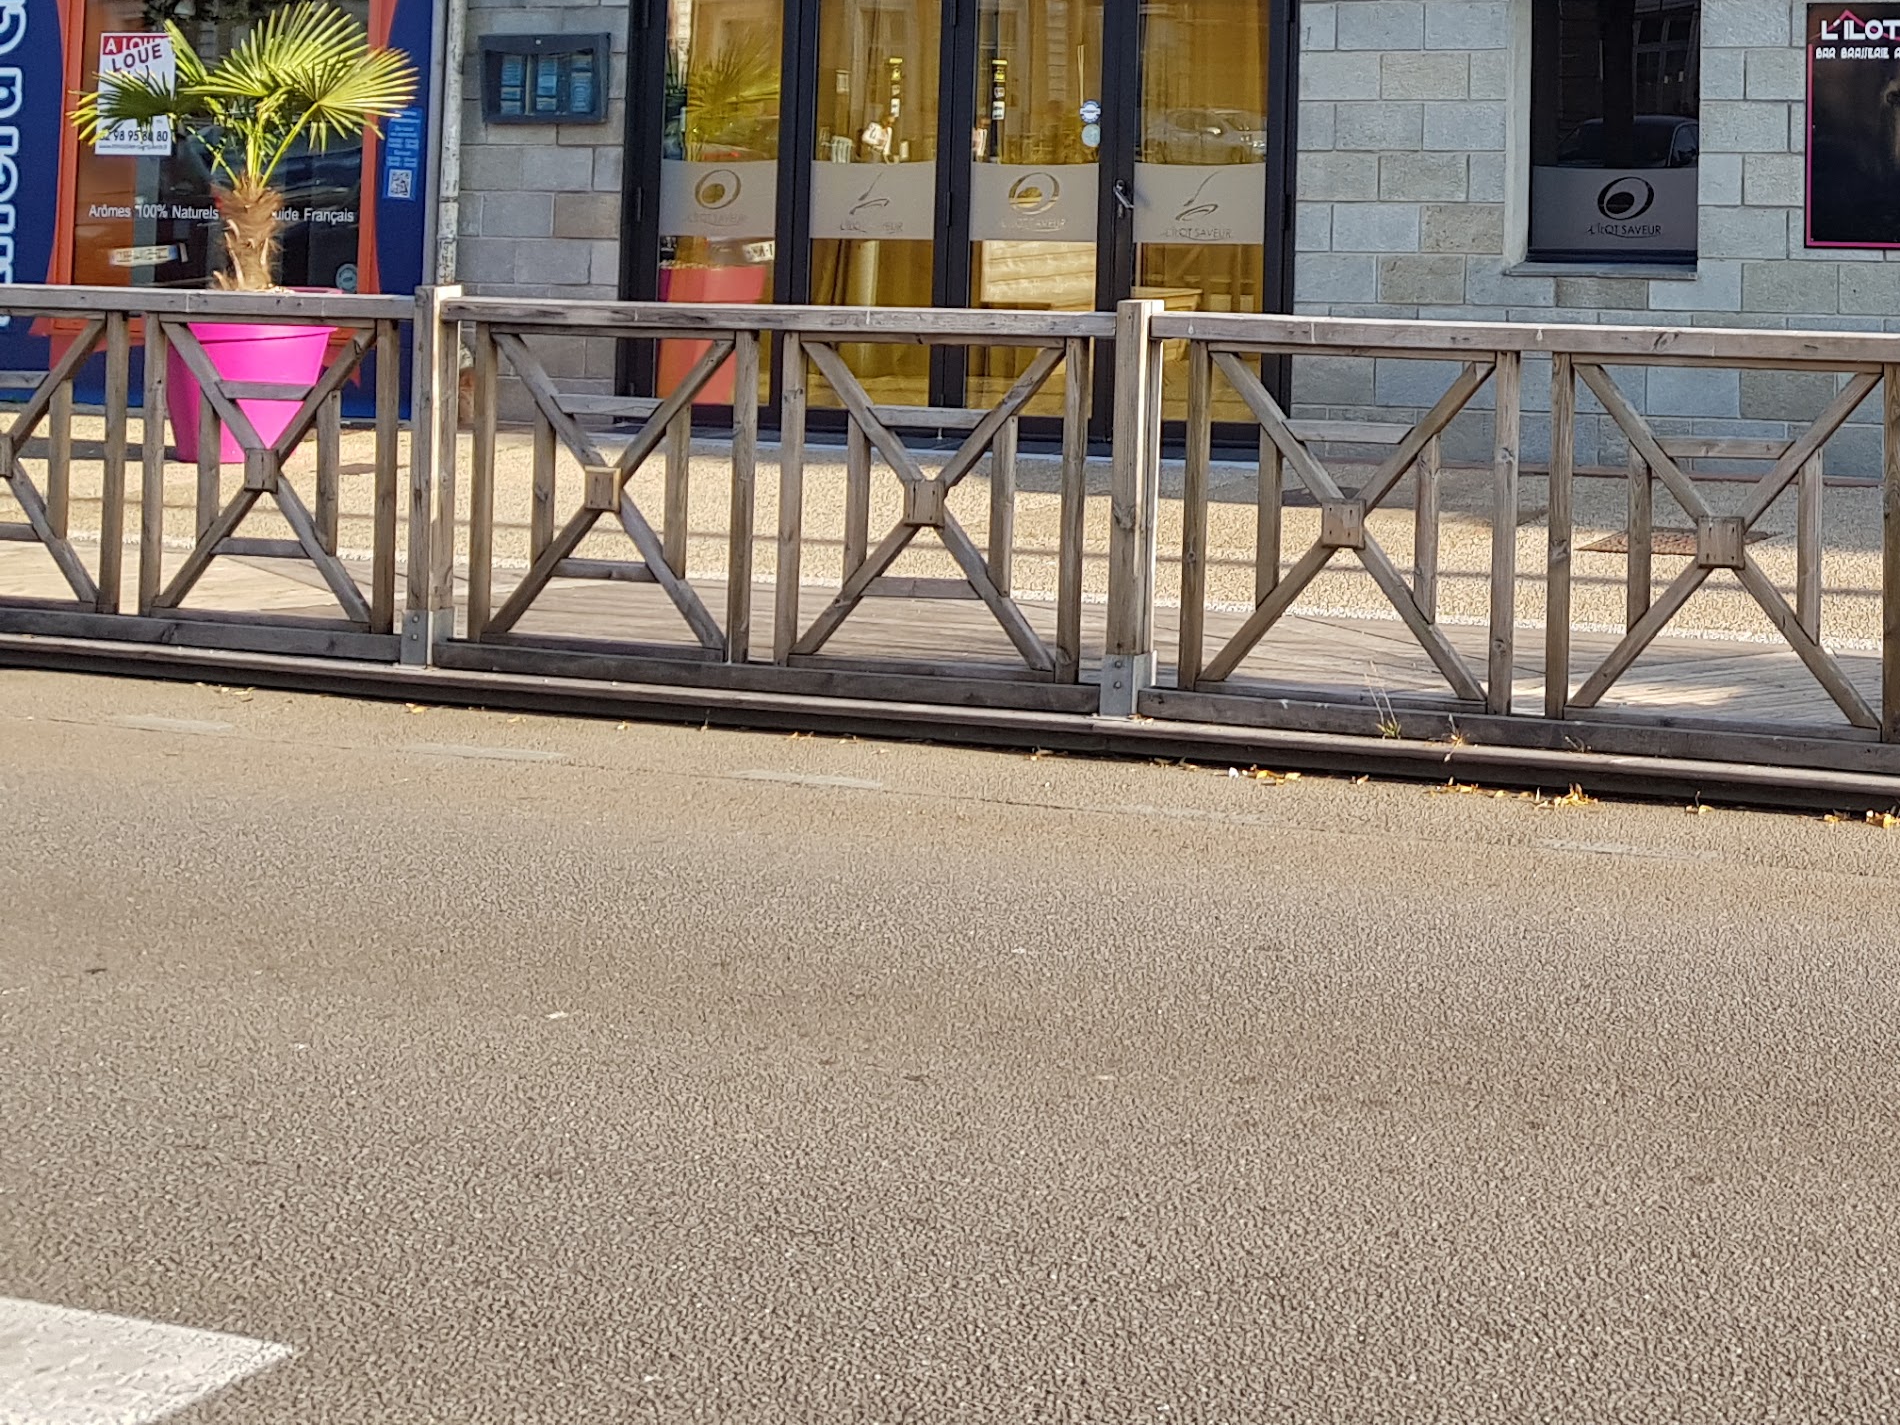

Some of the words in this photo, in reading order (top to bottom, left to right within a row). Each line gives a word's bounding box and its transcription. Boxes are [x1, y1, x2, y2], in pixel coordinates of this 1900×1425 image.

[112, 43, 163, 73] LOUE
[1815, 47, 1836, 60] BAR
[1840, 47, 1890, 60] BRASSERIE
[156, 130, 168, 142] 80
[88, 204, 132, 218] Arômes
[136, 204, 168, 219] 100%
[172, 205, 220, 220] Naturels
[303, 208, 355, 224] Français
[1621, 224, 1662, 235] SAVEUR
